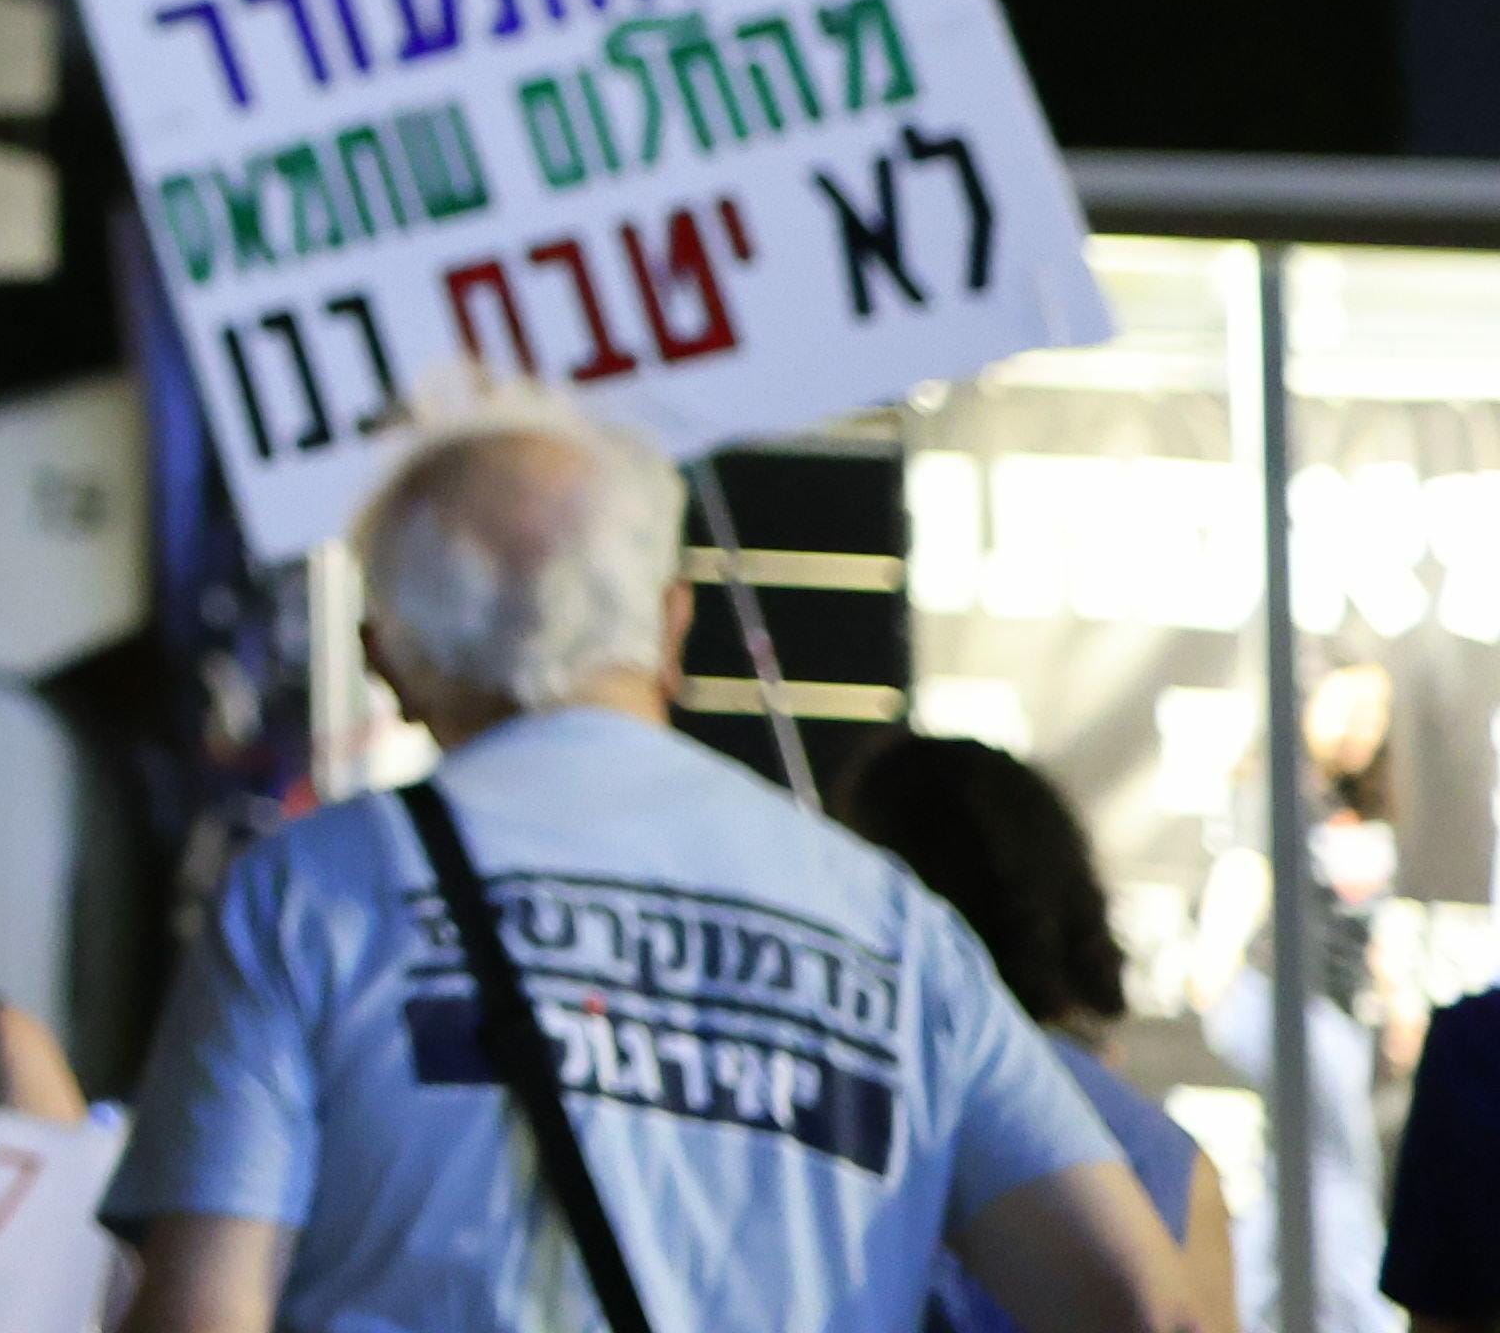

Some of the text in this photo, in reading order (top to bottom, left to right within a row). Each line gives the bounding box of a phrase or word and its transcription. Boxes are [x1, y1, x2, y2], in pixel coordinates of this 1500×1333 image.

[160, 102, 489, 282] שחמאס
[221, 125, 994, 460] לא יטבח בנו
[418, 895, 899, 1033] הדמוקרטם
[536, 993, 663, 1104] גול
